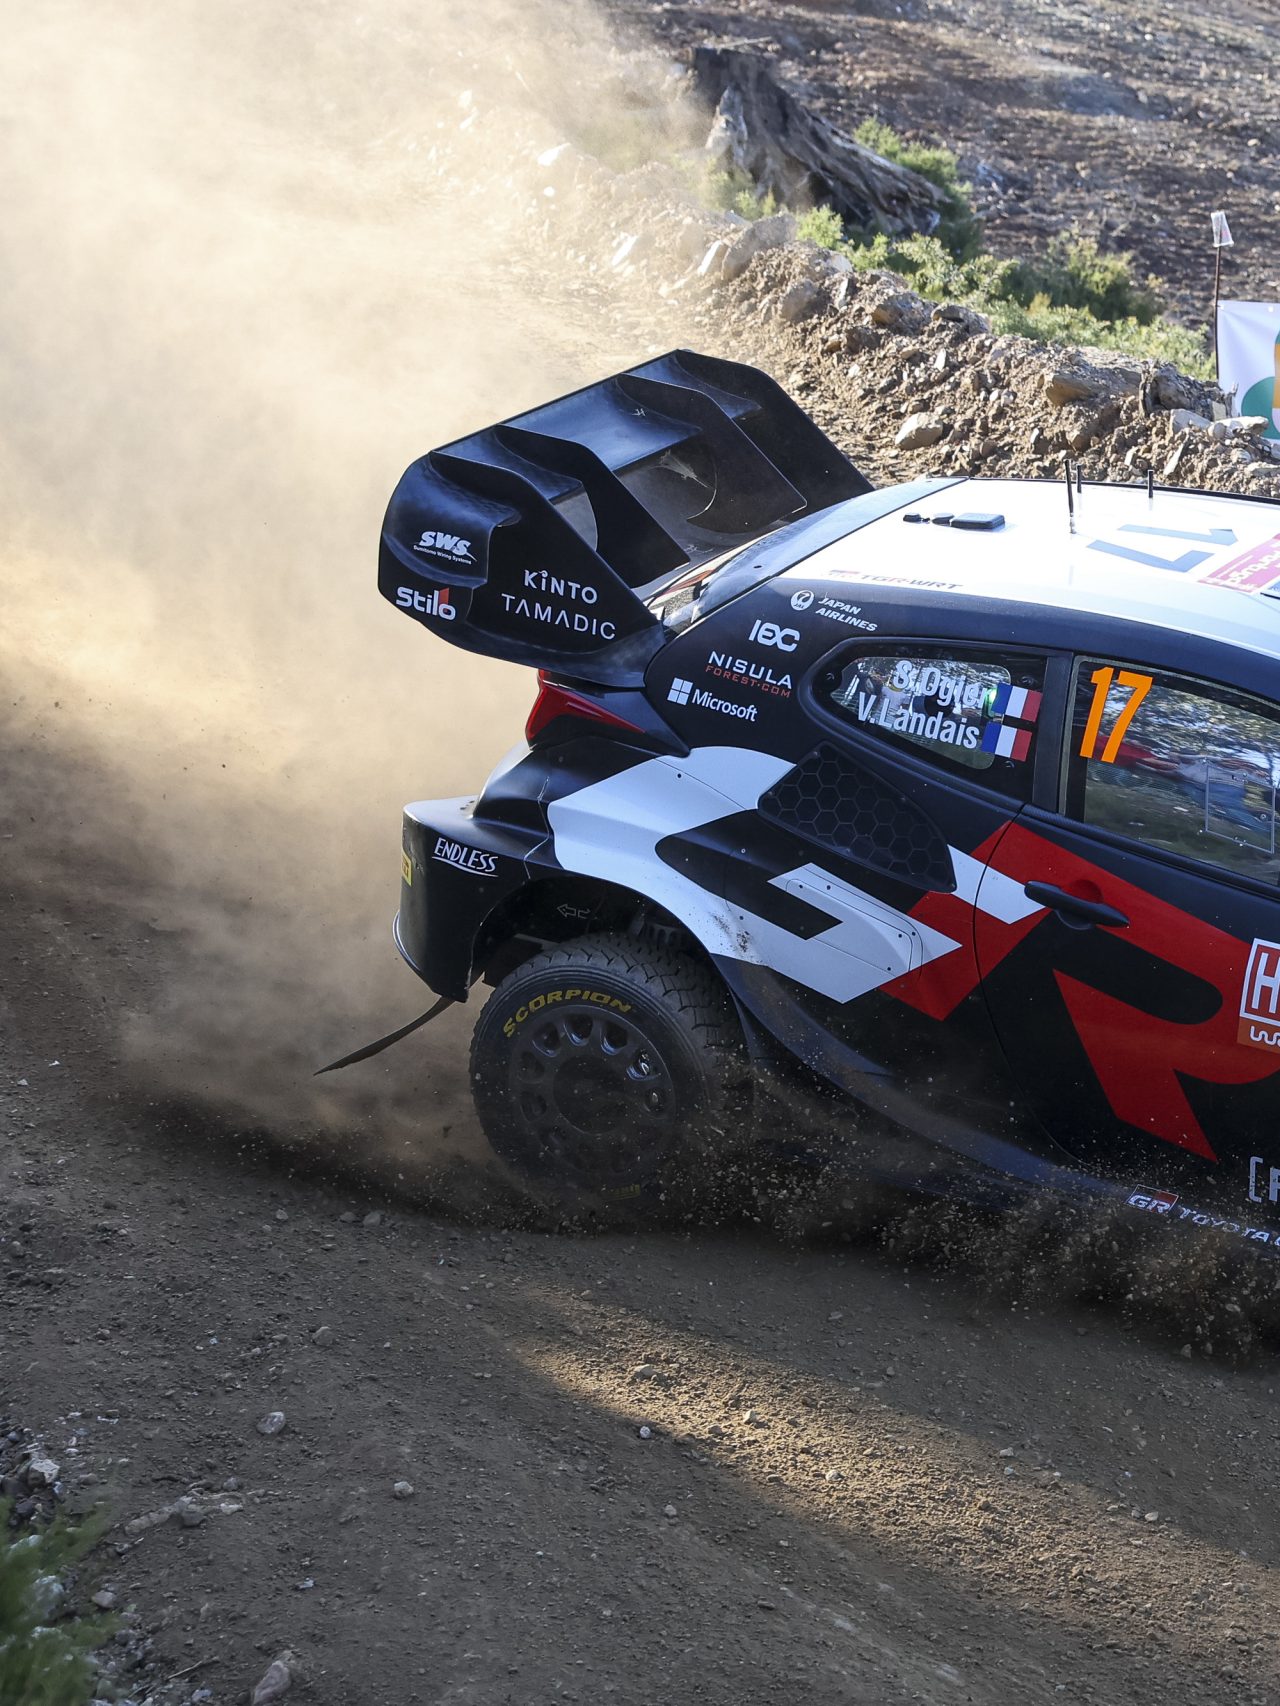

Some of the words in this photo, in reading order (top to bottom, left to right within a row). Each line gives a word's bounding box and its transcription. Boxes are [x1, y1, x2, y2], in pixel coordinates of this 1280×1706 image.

[419, 531, 475, 559] SWS
[396, 587, 457, 621] Stilo
[501, 593, 616, 640] TAMADIC
[816, 606, 879, 632] AIRLINES
[818, 595, 862, 615] JAPAN
[708, 651, 793, 690] NISULA
[691, 688, 758, 722] Microsoft
[857, 691, 981, 750] V.Landais
[1079, 666, 1154, 763] 17
[433, 837, 499, 874] ENDLESS
[503, 989, 632, 1038] SCORPION
[1128, 1195, 1170, 1214] GR
[1178, 1206, 1271, 1243] TOYOTA
